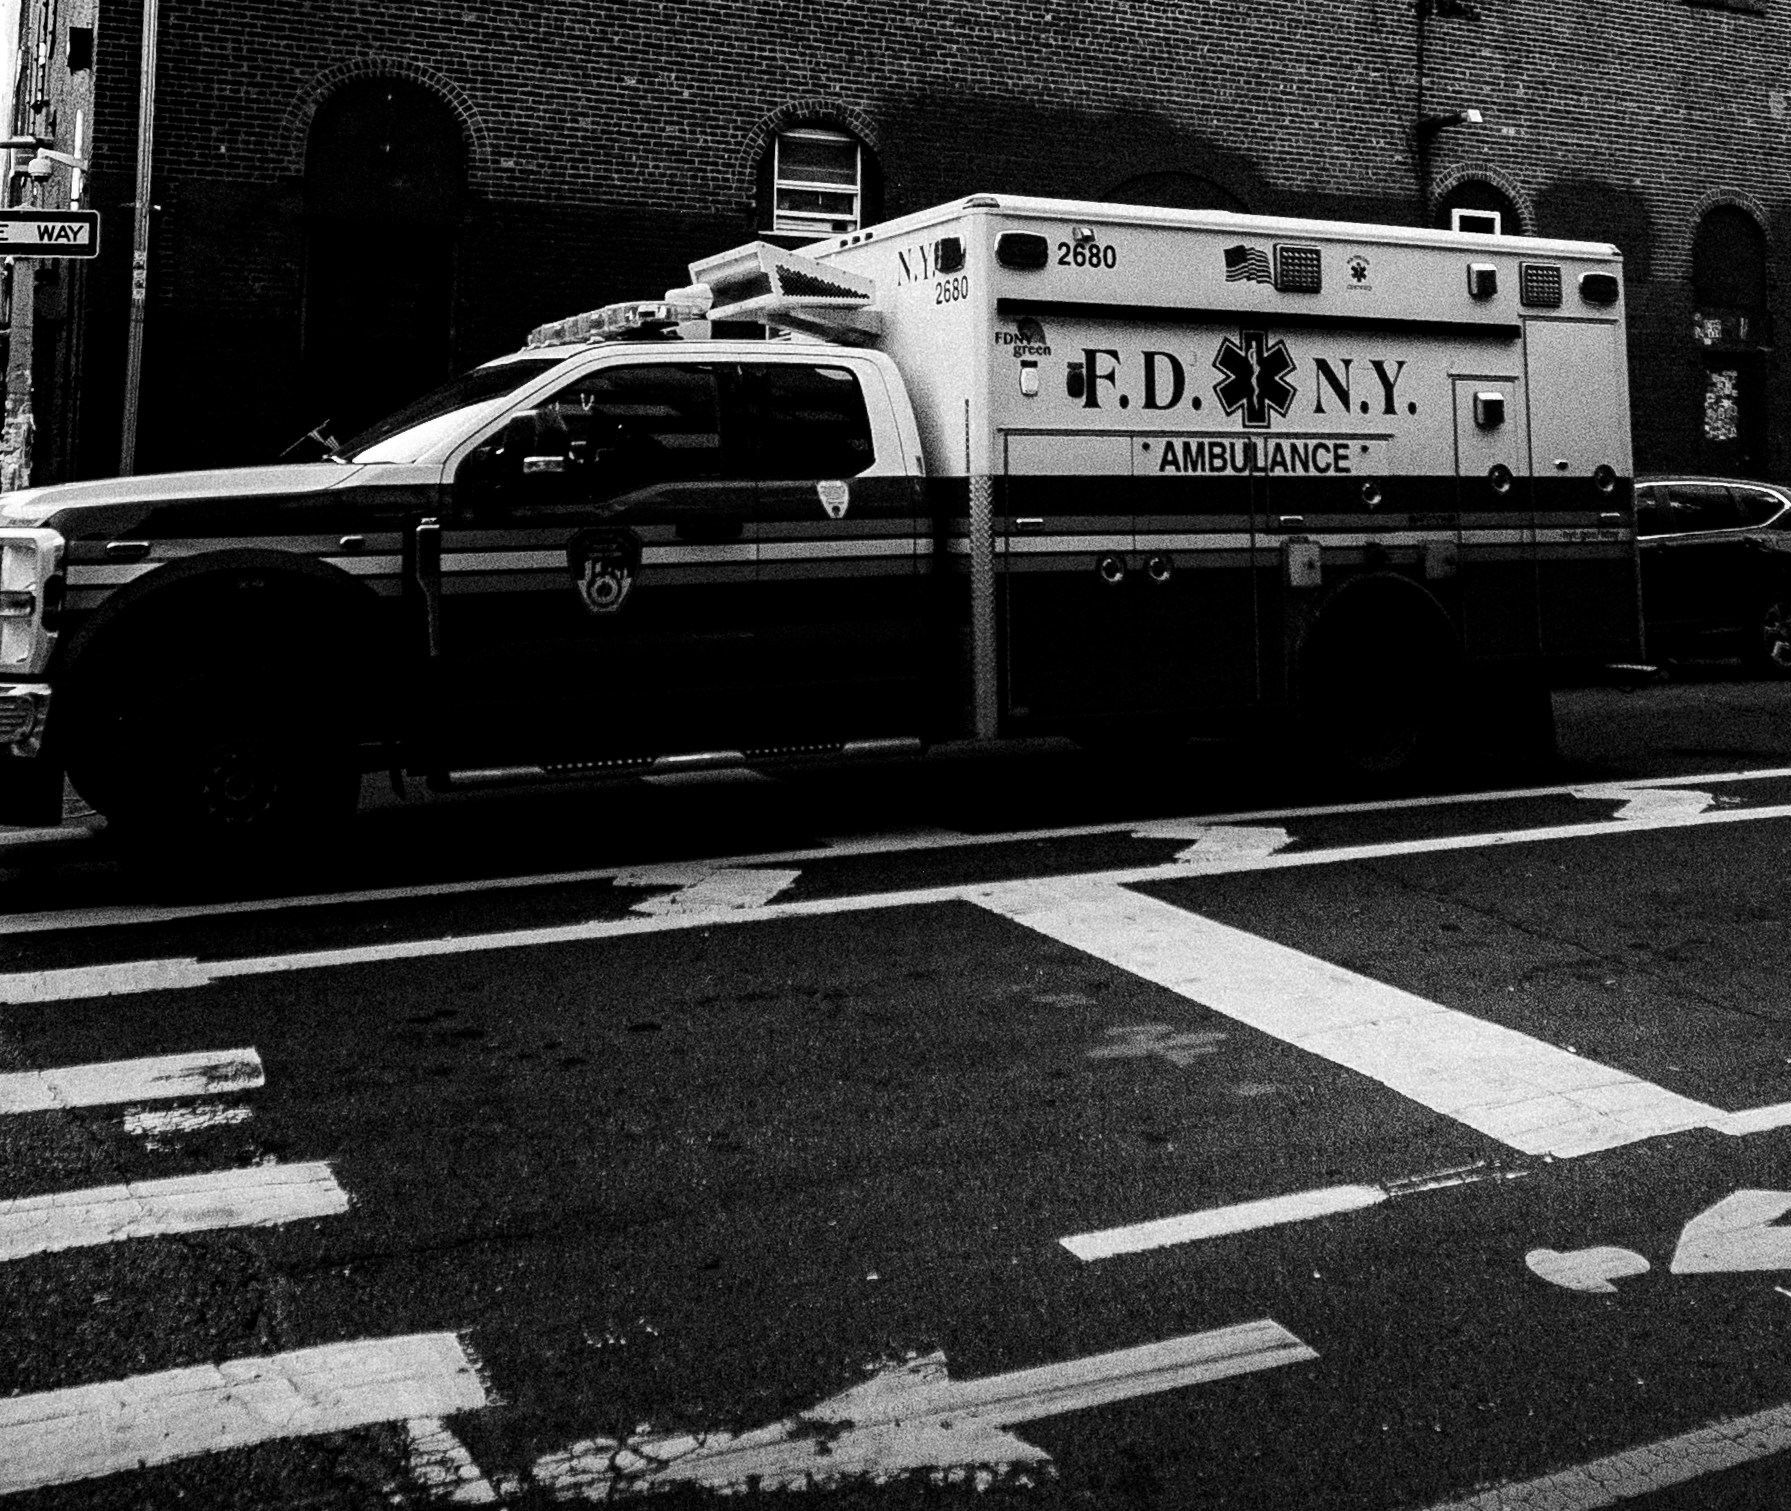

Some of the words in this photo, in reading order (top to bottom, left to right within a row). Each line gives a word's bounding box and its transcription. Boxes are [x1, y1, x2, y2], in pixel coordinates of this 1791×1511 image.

[36, 224, 84, 243] WAY
[1057, 241, 1117, 269] 2680
[935, 275, 969, 305] 2680
[994, 331, 1032, 346] FDNY
[1012, 344, 1052, 359] green
[1081, 347, 1203, 412] F.D.
[1313, 357, 1417, 416] N.Y.
[1158, 438, 1352, 475] AMBULANCE
